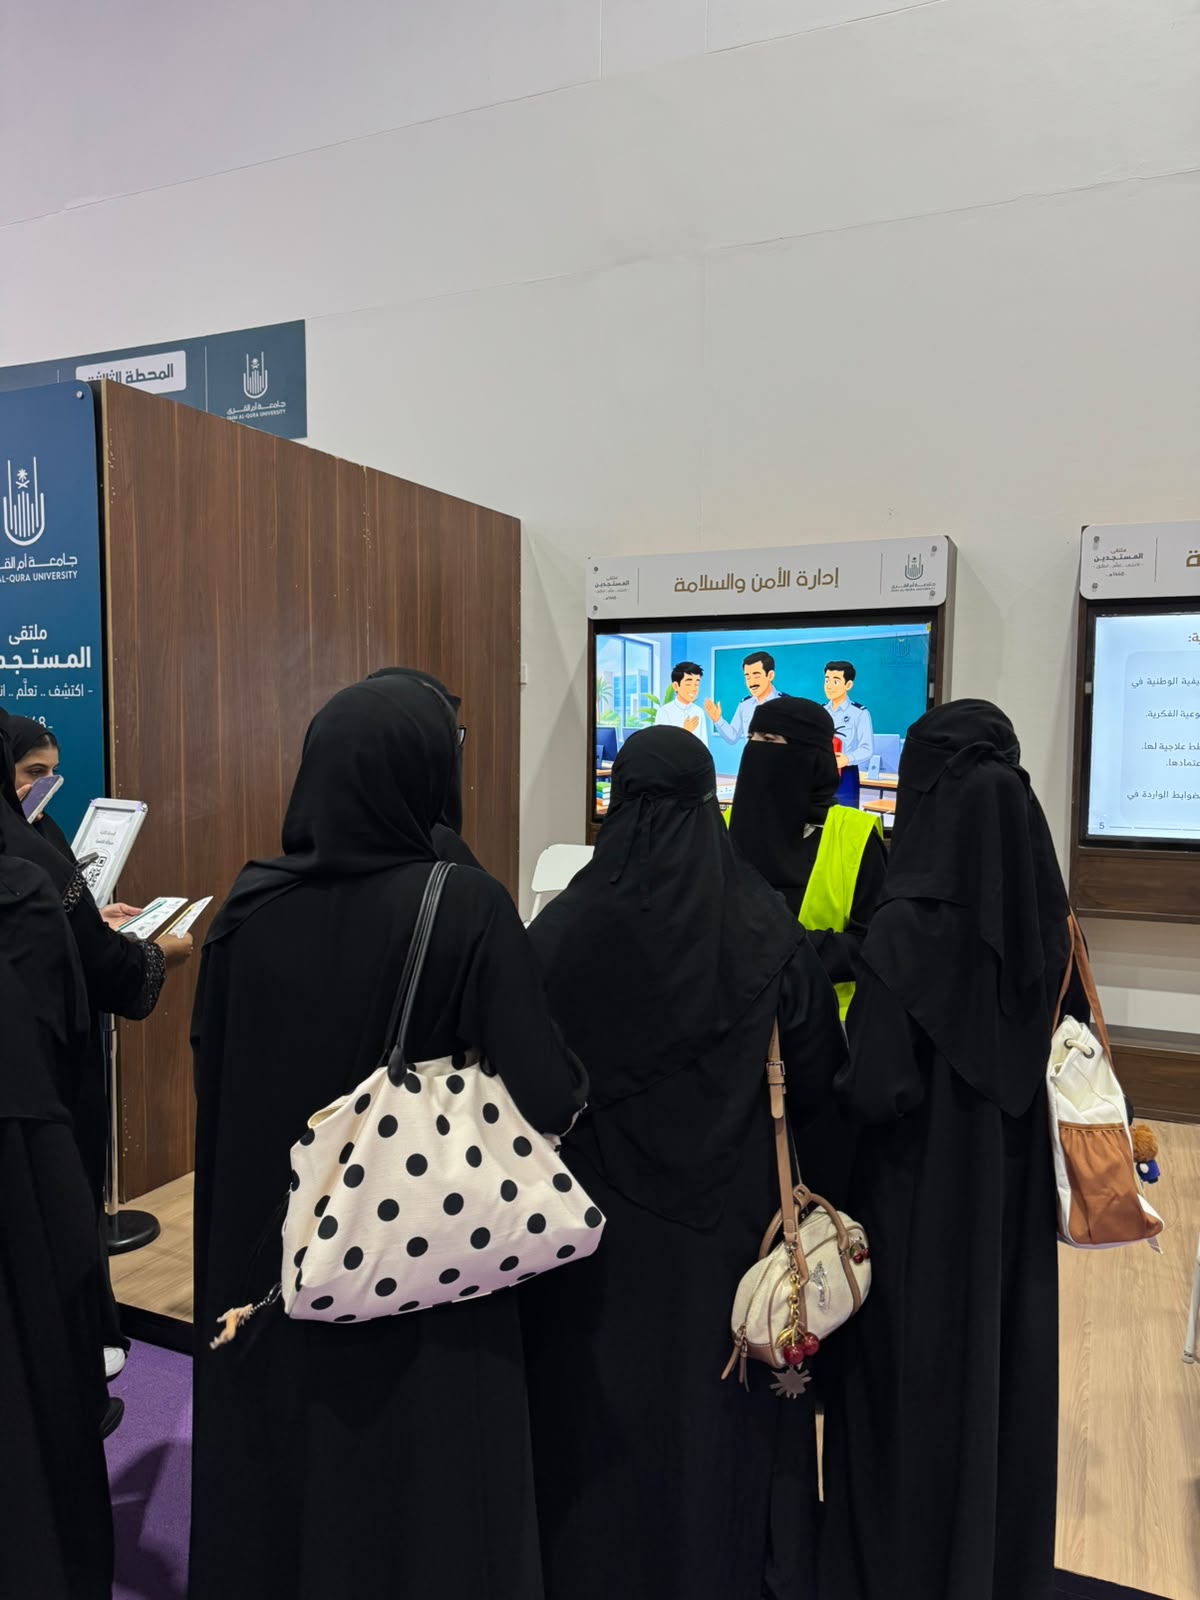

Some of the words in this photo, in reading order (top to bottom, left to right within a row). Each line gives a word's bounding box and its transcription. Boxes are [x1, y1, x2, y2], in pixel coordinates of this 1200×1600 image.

[125, 363, 174, 384] المحطة
[259, 409, 286, 417] UNIVERSITY
[16, 552, 28, 571] أم
[1093, 552, 1144, 563] المستجدين
[32, 570, 78, 582] UNIVERSITY
[751, 566, 791, 592] الأمن
[796, 567, 839, 590] إدارة
[674, 573, 746, 593] والسلامة
[8, 623, 48, 645] ملتقى
[1131, 677, 1144, 689] في
[1146, 676, 1178, 688] الوطنية
[1126, 790, 1139, 801] في
[1142, 790, 1169, 800] الواردة
[1098, 821, 1105, 830] 5
